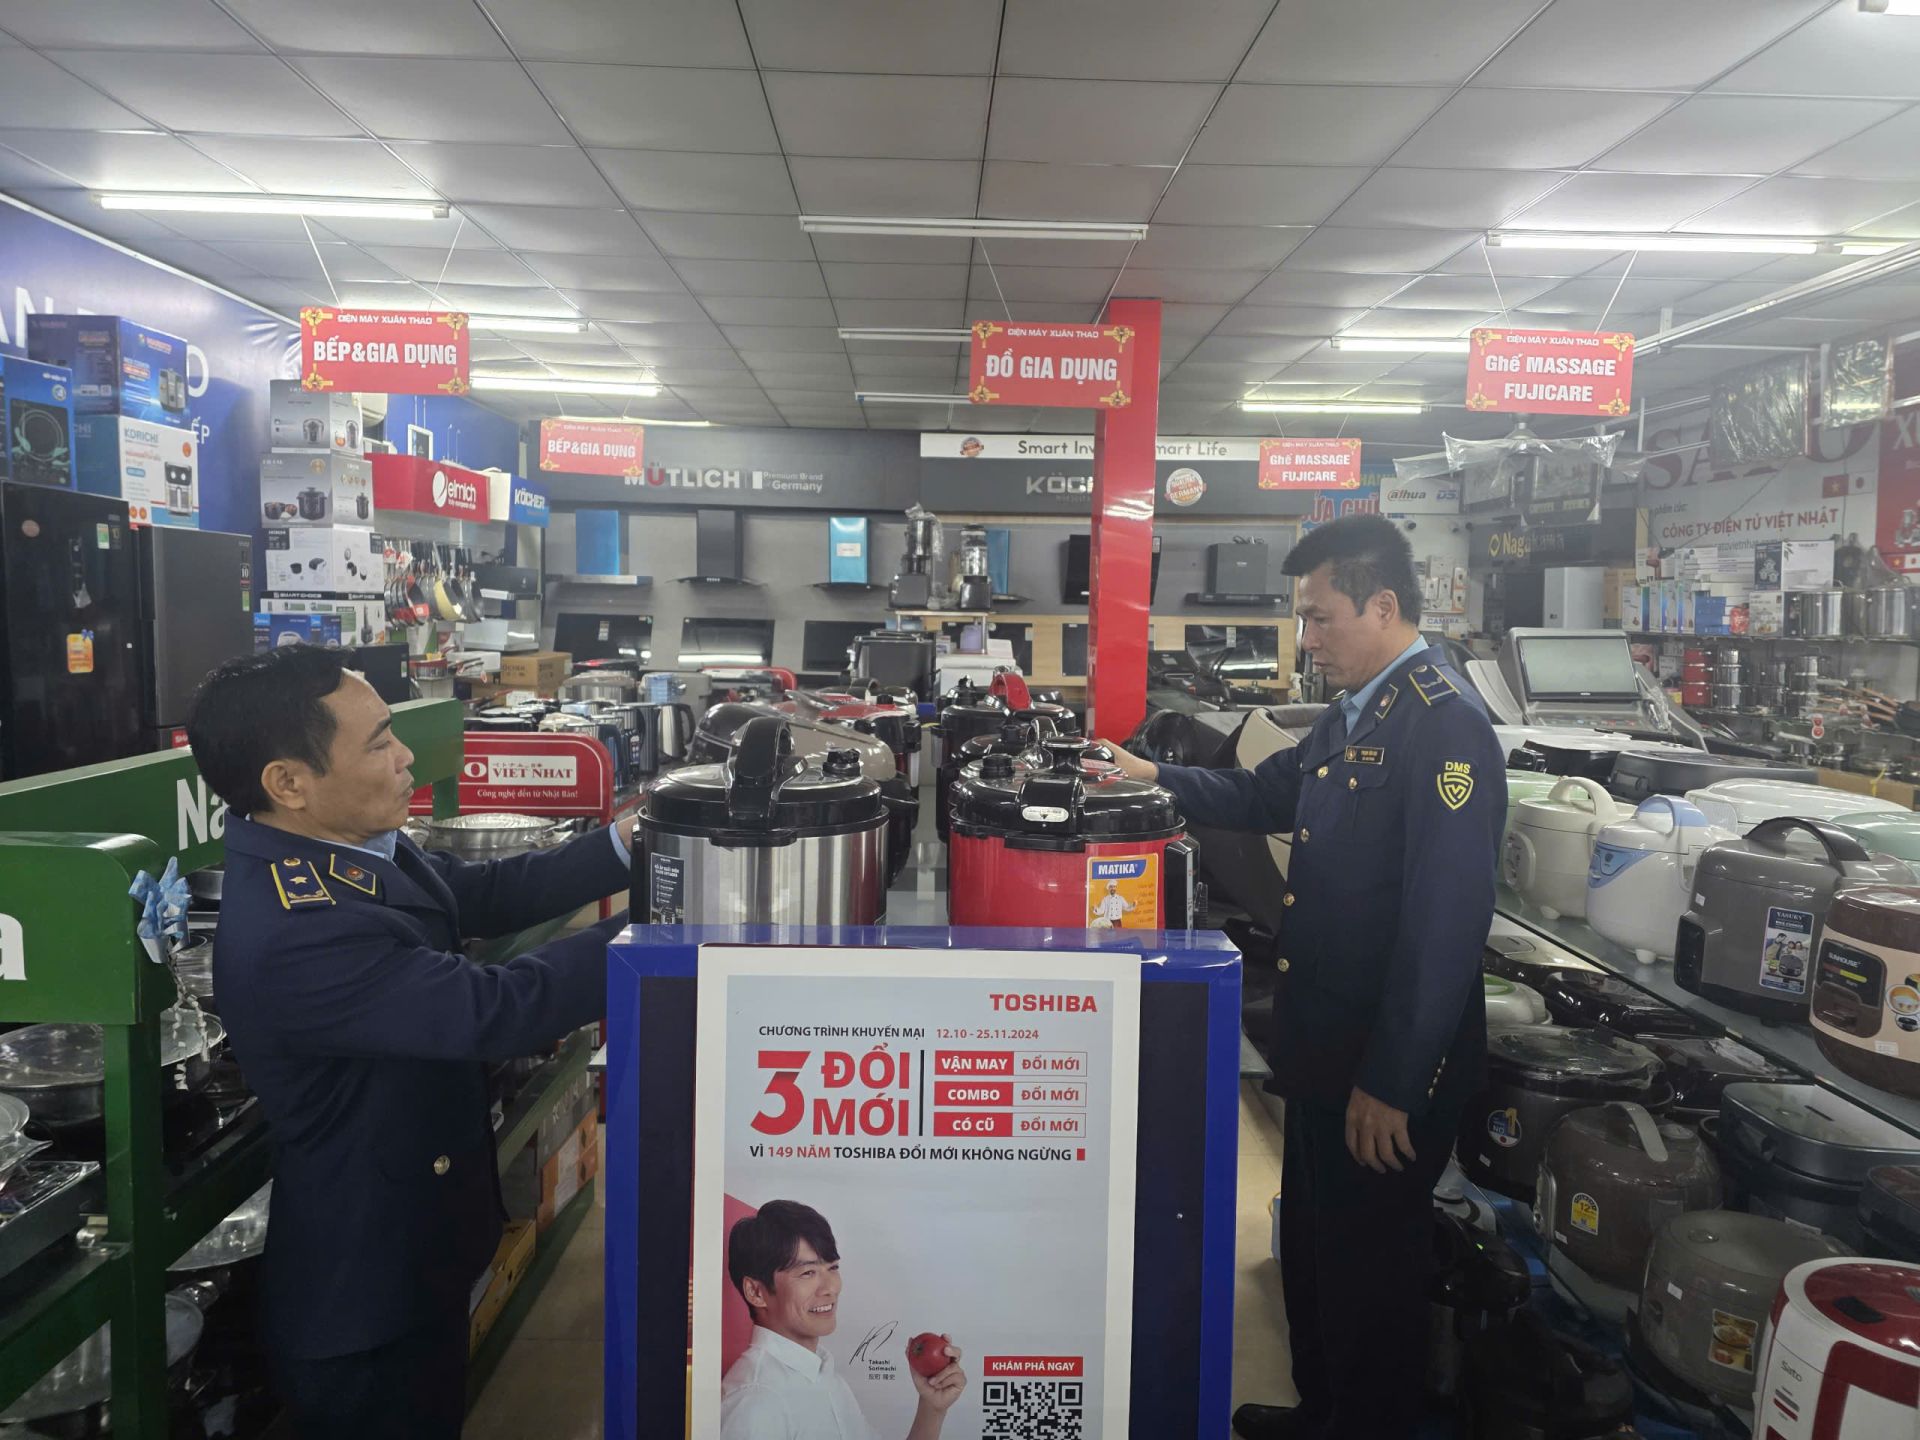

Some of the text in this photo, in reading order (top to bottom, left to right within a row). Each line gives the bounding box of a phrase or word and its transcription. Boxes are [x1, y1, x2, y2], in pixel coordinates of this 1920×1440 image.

[359, 314, 379, 324] MÁY
[1028, 328, 1047, 337] MÁY
[1528, 335, 1547, 344] MÁY
[313, 334, 457, 368] BẾP&GIA DỤNG
[986, 347, 1117, 385] ĐỒ GIA DỤNG
[1485, 353, 1616, 376] Ghế MASSAGE
[1504, 382, 1593, 402] FUJICARE
[548, 436, 635, 460] BẾP&GIA DỤNG
[1018, 440, 1068, 455] Smart
[1198, 441, 1228, 456] Life
[1295, 455, 1350, 465] MASSAGE
[763, 472, 823, 480] Premium Brand
[1282, 472, 1337, 482] FUJICARE
[448, 480, 476, 503] elmich
[772, 480, 823, 493] Germany
[514, 488, 545, 509] KÖCHER
[1662, 523, 1693, 538] CÔNG
[1765, 512, 1794, 532] VIỆT
[1798, 506, 1839, 528] NHẬT
[1445, 761, 1471, 774] DMS
[477, 789, 496, 798] Công
[1098, 864, 1135, 874] MATIKA
[990, 993, 1098, 1013] TOSHIBA
[759, 1025, 811, 1037] CHƯƠNG
[814, 1024, 849, 1037] TRÌNH
[852, 1025, 900, 1038] KHUYẾN
[903, 1028, 925, 1040] MẠI
[937, 1029, 967, 1039] 12.10
[977, 1029, 1039, 1039] 25.11.2024
[821, 1042, 910, 1090] ĐỔI
[941, 1055, 1080, 1072] VẬN MAY ĐỔI MỚI
[750, 1050, 811, 1136] 3
[948, 1086, 1079, 1101] COMBO ĐỔI MỚI
[812, 1092, 909, 1137] MỚI
[952, 1116, 1078, 1132] CÓ CŨ ĐỔI MỚI
[750, 1144, 1071, 1161] VÌ 149 NĂM TOSHIBA ĐỔI MỚI KHÔNG NGỪNG
[992, 1360, 1075, 1371] KHÁM PHÁ NGAY
